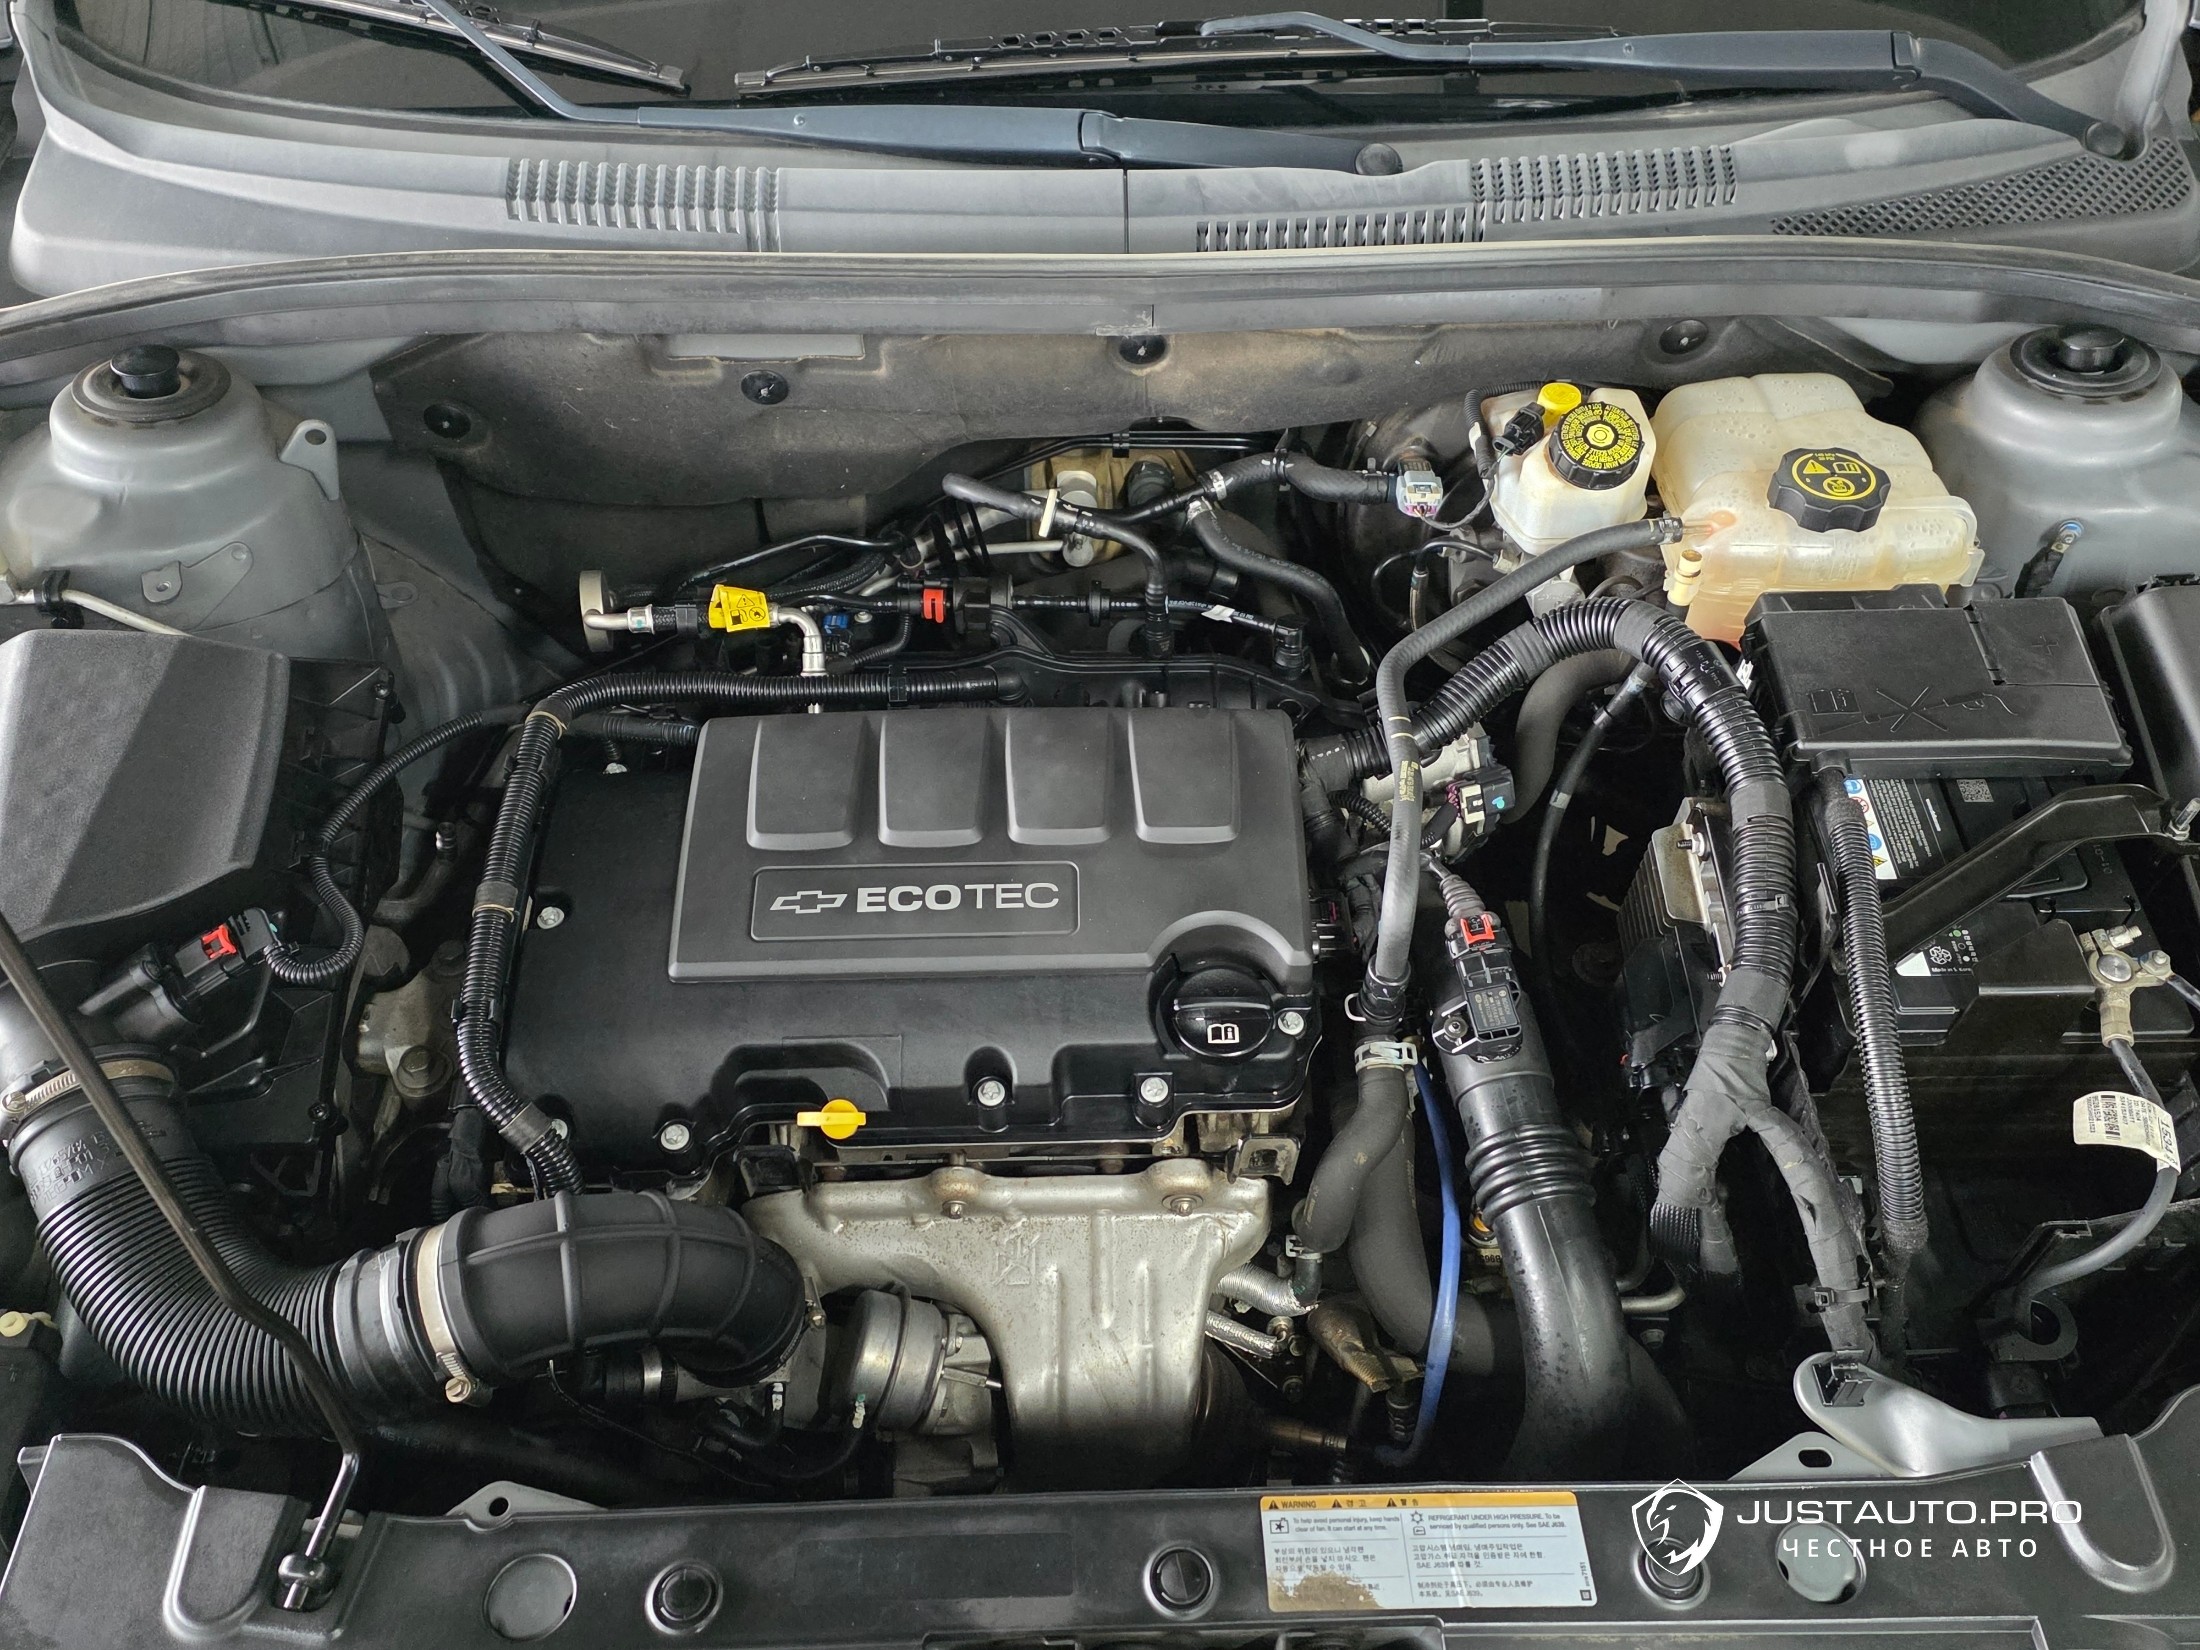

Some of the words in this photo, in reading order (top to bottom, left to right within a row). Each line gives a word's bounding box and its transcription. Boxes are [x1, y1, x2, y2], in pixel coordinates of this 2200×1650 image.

[856, 882, 1059, 913] ECOTEC
[1281, 1500, 1317, 1509] WARNING
[1463, 1522, 1486, 1530] qualified
